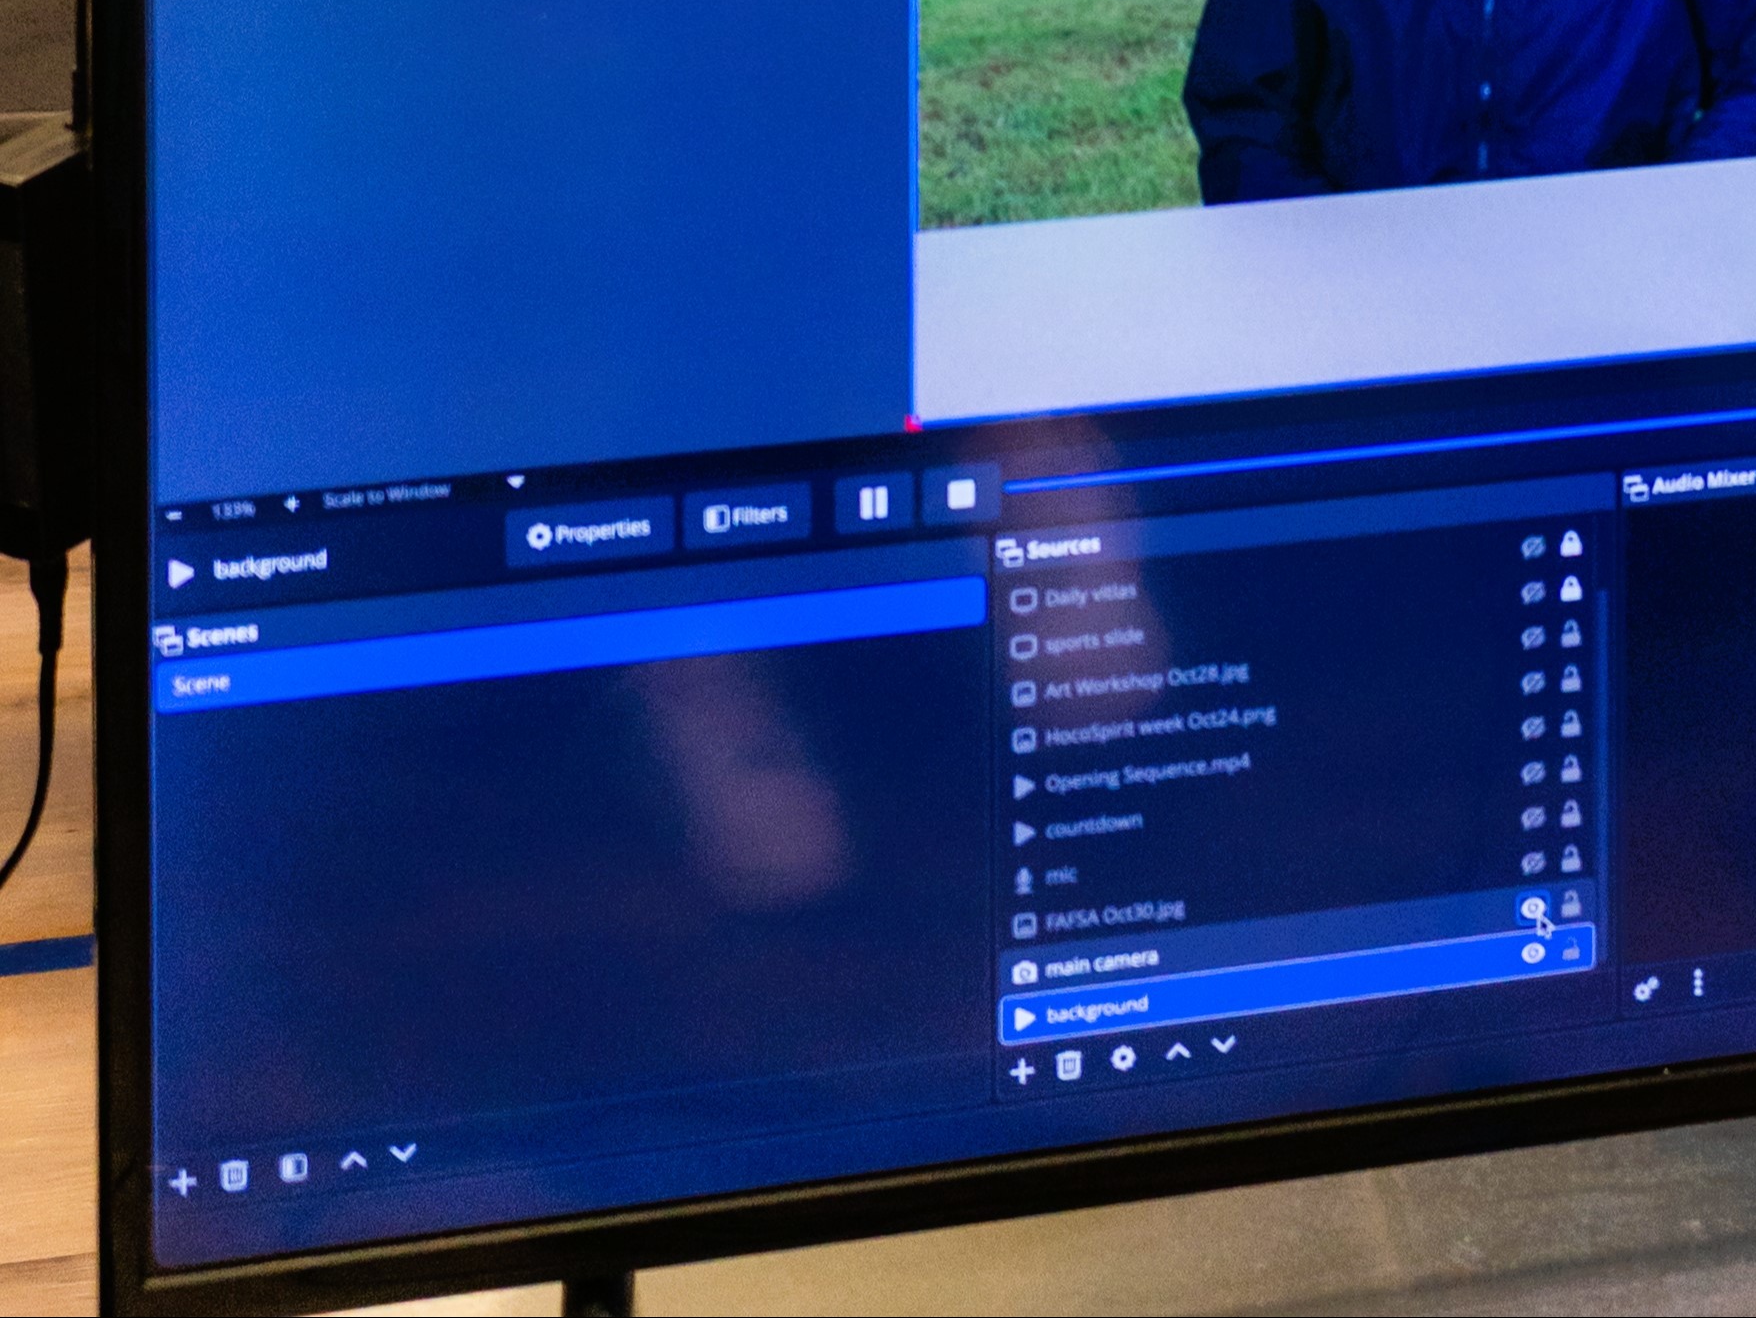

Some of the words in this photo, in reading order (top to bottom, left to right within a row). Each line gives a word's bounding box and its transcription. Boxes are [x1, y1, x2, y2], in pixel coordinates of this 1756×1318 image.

[1652, 472, 1705, 495] Audio
[323, 491, 365, 510] Scale
[367, 490, 385, 506] to
[386, 483, 451, 502] Window
[732, 505, 788, 526] Filters
[555, 518, 651, 546] Properties
[1026, 537, 1100, 559] Sources
[213, 548, 328, 581] background
[1045, 587, 1086, 609] Daily
[187, 624, 258, 648] Scenes
[1045, 634, 1099, 656] sports
[1103, 626, 1145, 647] slide
[173, 675, 230, 697] Scene
[1046, 682, 1072, 699] Art
[1074, 673, 1163, 696] Workshop
[1139, 714, 1185, 735] week
[1045, 769, 1120, 795] Opening
[1123, 752, 1249, 785] Sequence.mp4
[1045, 813, 1143, 840] countdown
[1046, 866, 1077, 885] mic
[1046, 909, 1100, 931] FAFSA
[1045, 956, 1091, 978] main
[1093, 949, 1160, 972] camera
[1047, 994, 1149, 1024] background
